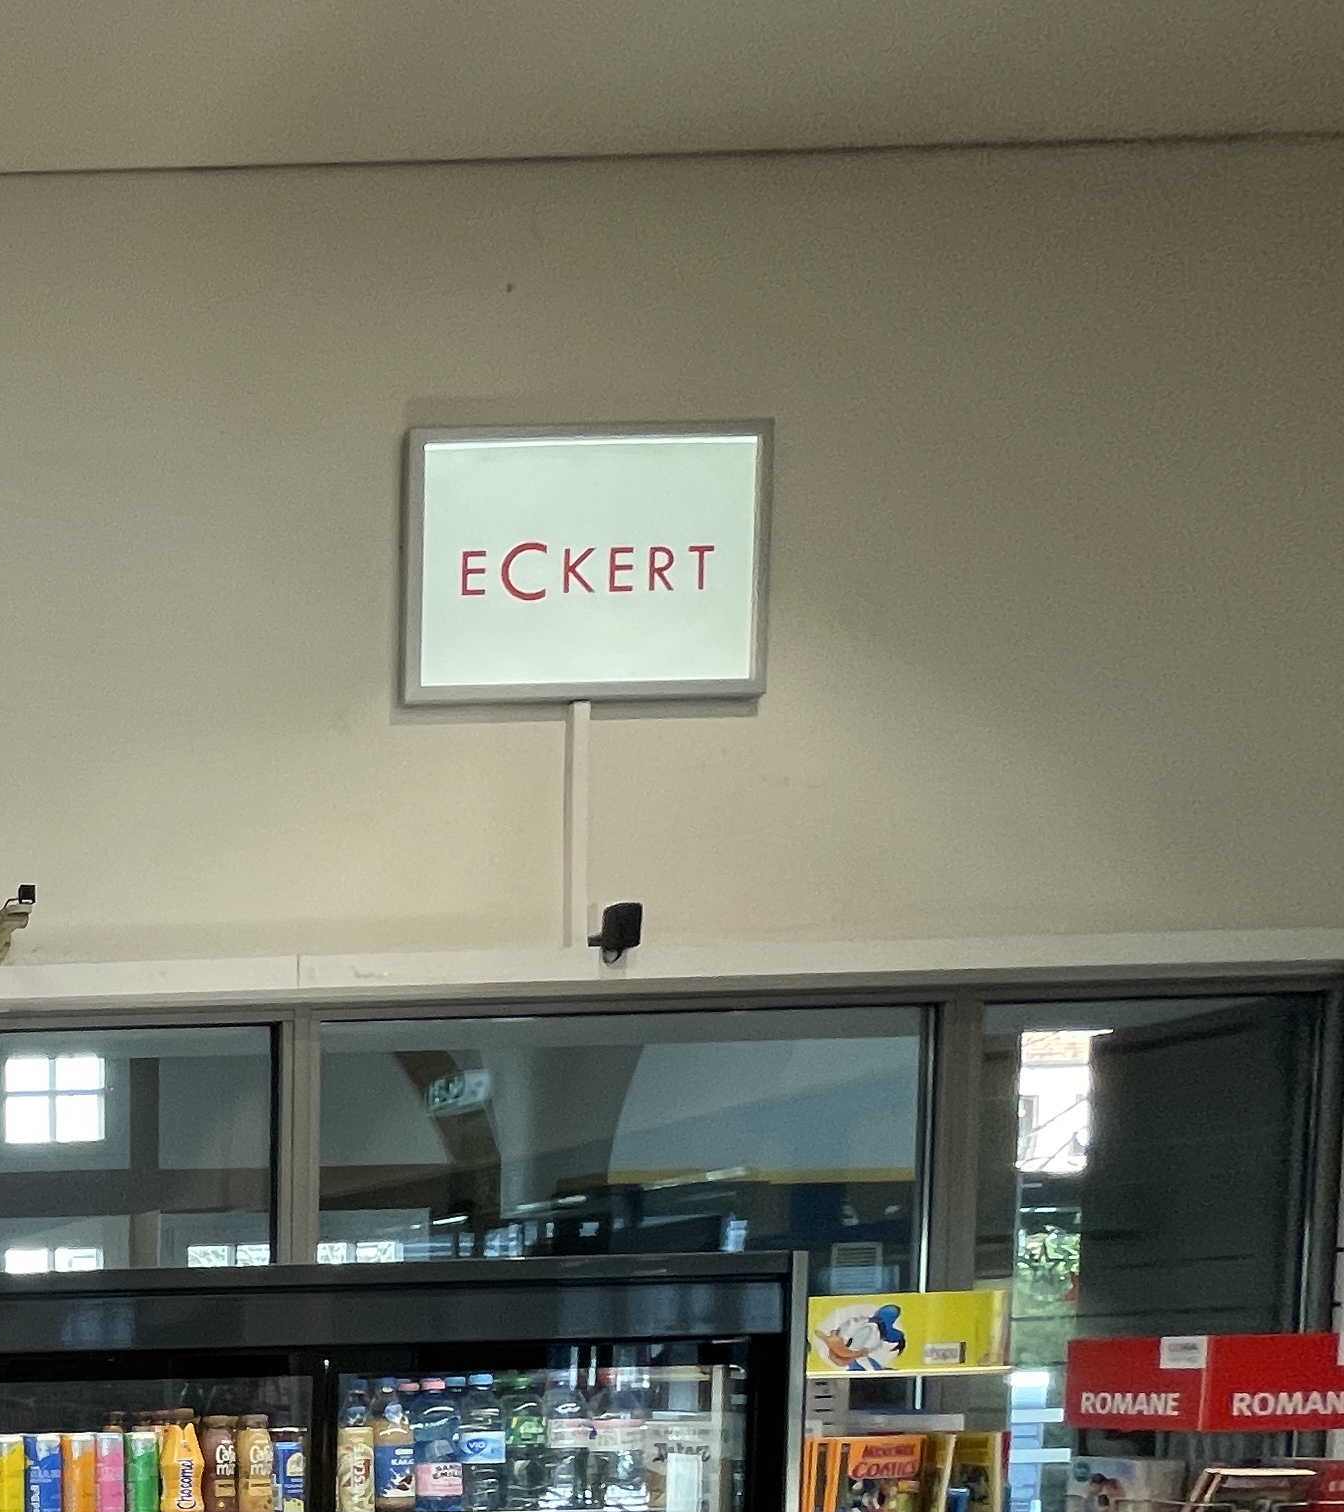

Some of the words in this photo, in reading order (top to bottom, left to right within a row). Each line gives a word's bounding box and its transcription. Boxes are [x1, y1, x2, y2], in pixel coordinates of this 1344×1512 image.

[461, 542, 714, 601] ECKERT
[1080, 1391, 1180, 1416] ROMANE
[1232, 1391, 1344, 1417] ROMAN
